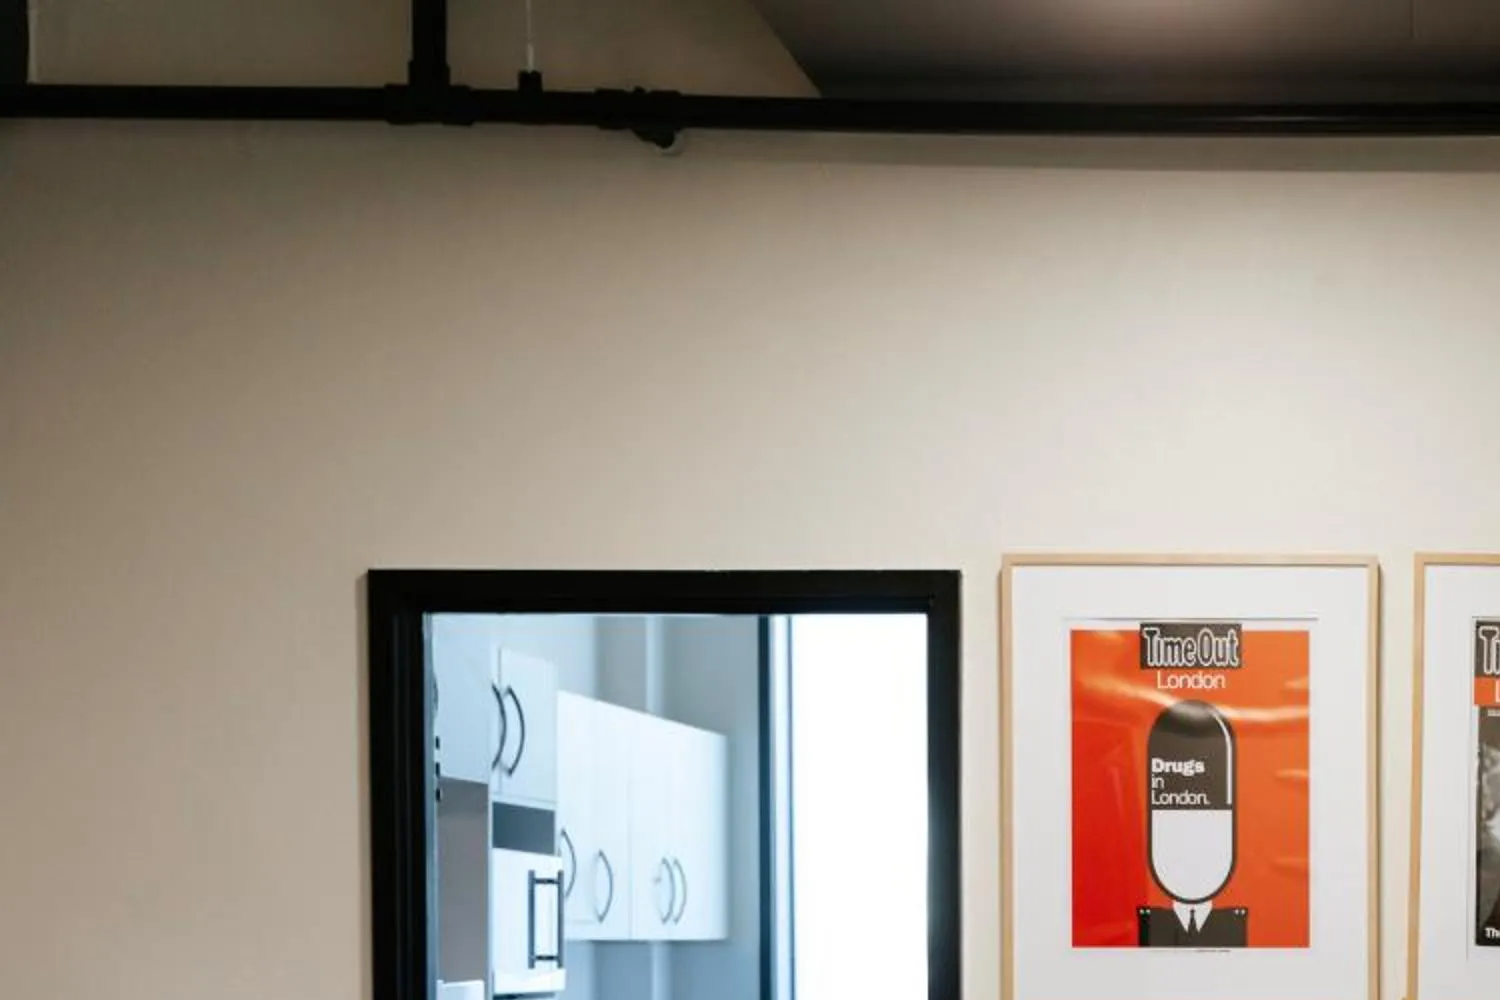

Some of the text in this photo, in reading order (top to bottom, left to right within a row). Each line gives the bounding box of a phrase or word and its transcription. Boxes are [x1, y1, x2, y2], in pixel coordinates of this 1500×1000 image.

[1143, 626, 1240, 667] Time Out
[1156, 670, 1226, 689] London
[1151, 757, 1205, 776] Drugs
[1151, 773, 1165, 789] in
[1151, 789, 1211, 805] London.
